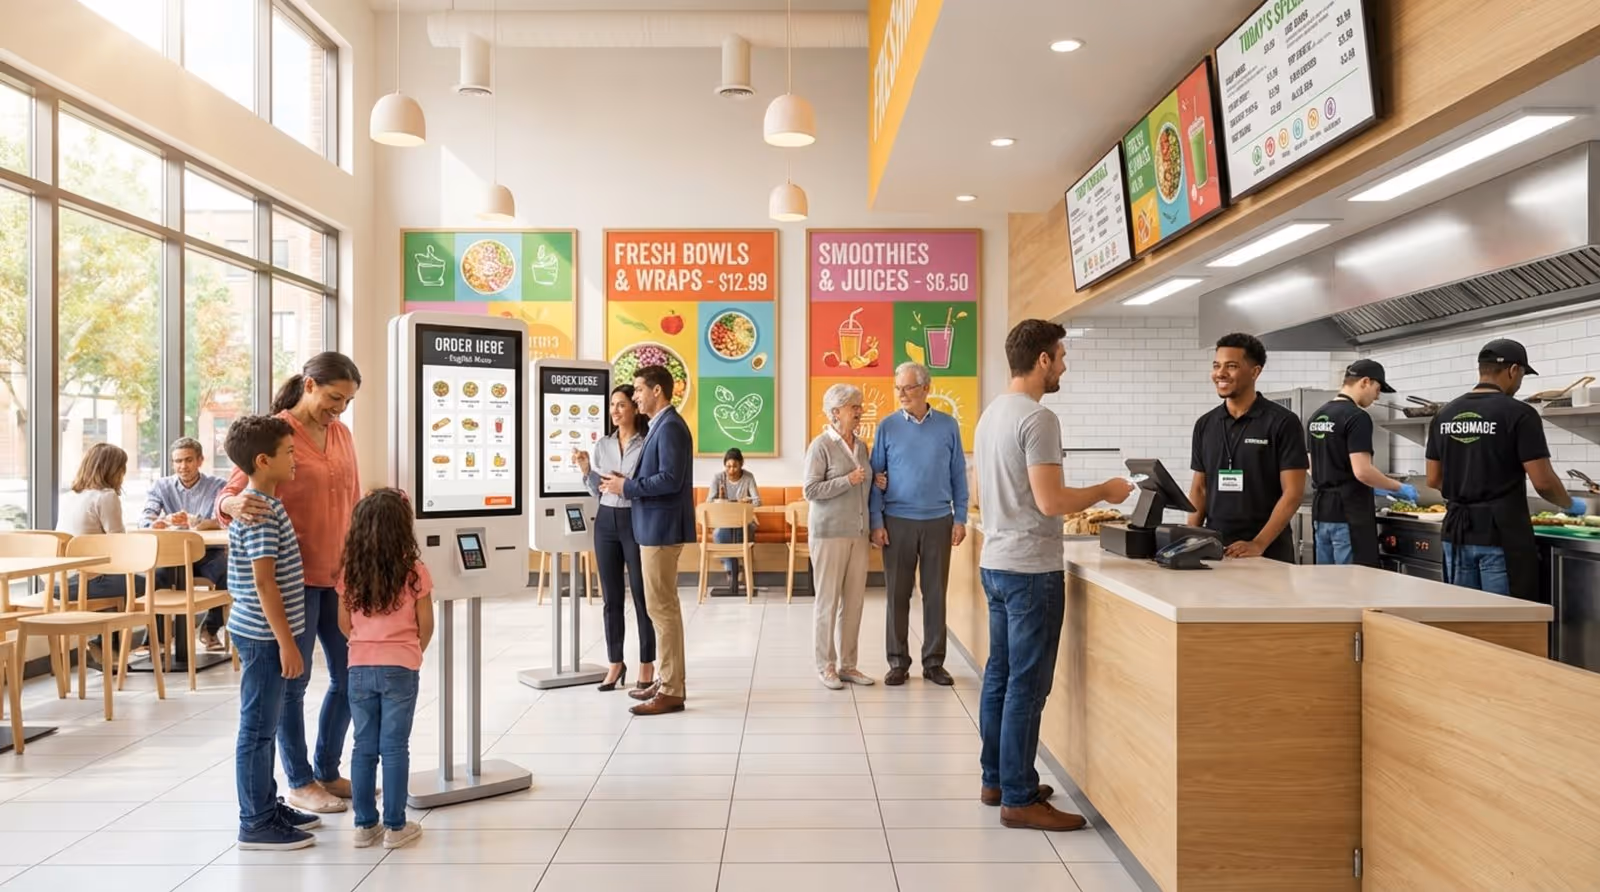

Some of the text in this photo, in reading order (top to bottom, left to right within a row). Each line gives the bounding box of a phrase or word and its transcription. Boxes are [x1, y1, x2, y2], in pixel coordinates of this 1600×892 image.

[614, 242, 749, 265] FRESH BOWLS
[819, 242, 929, 265] SMOOTHIES
[614, 269, 630, 291] &
[636, 269, 703, 291] WRAPS
[719, 272, 768, 292] $12.99
[819, 269, 834, 291] &
[841, 269, 909, 291] JUICES
[435, 337, 472, 353] ORDER
